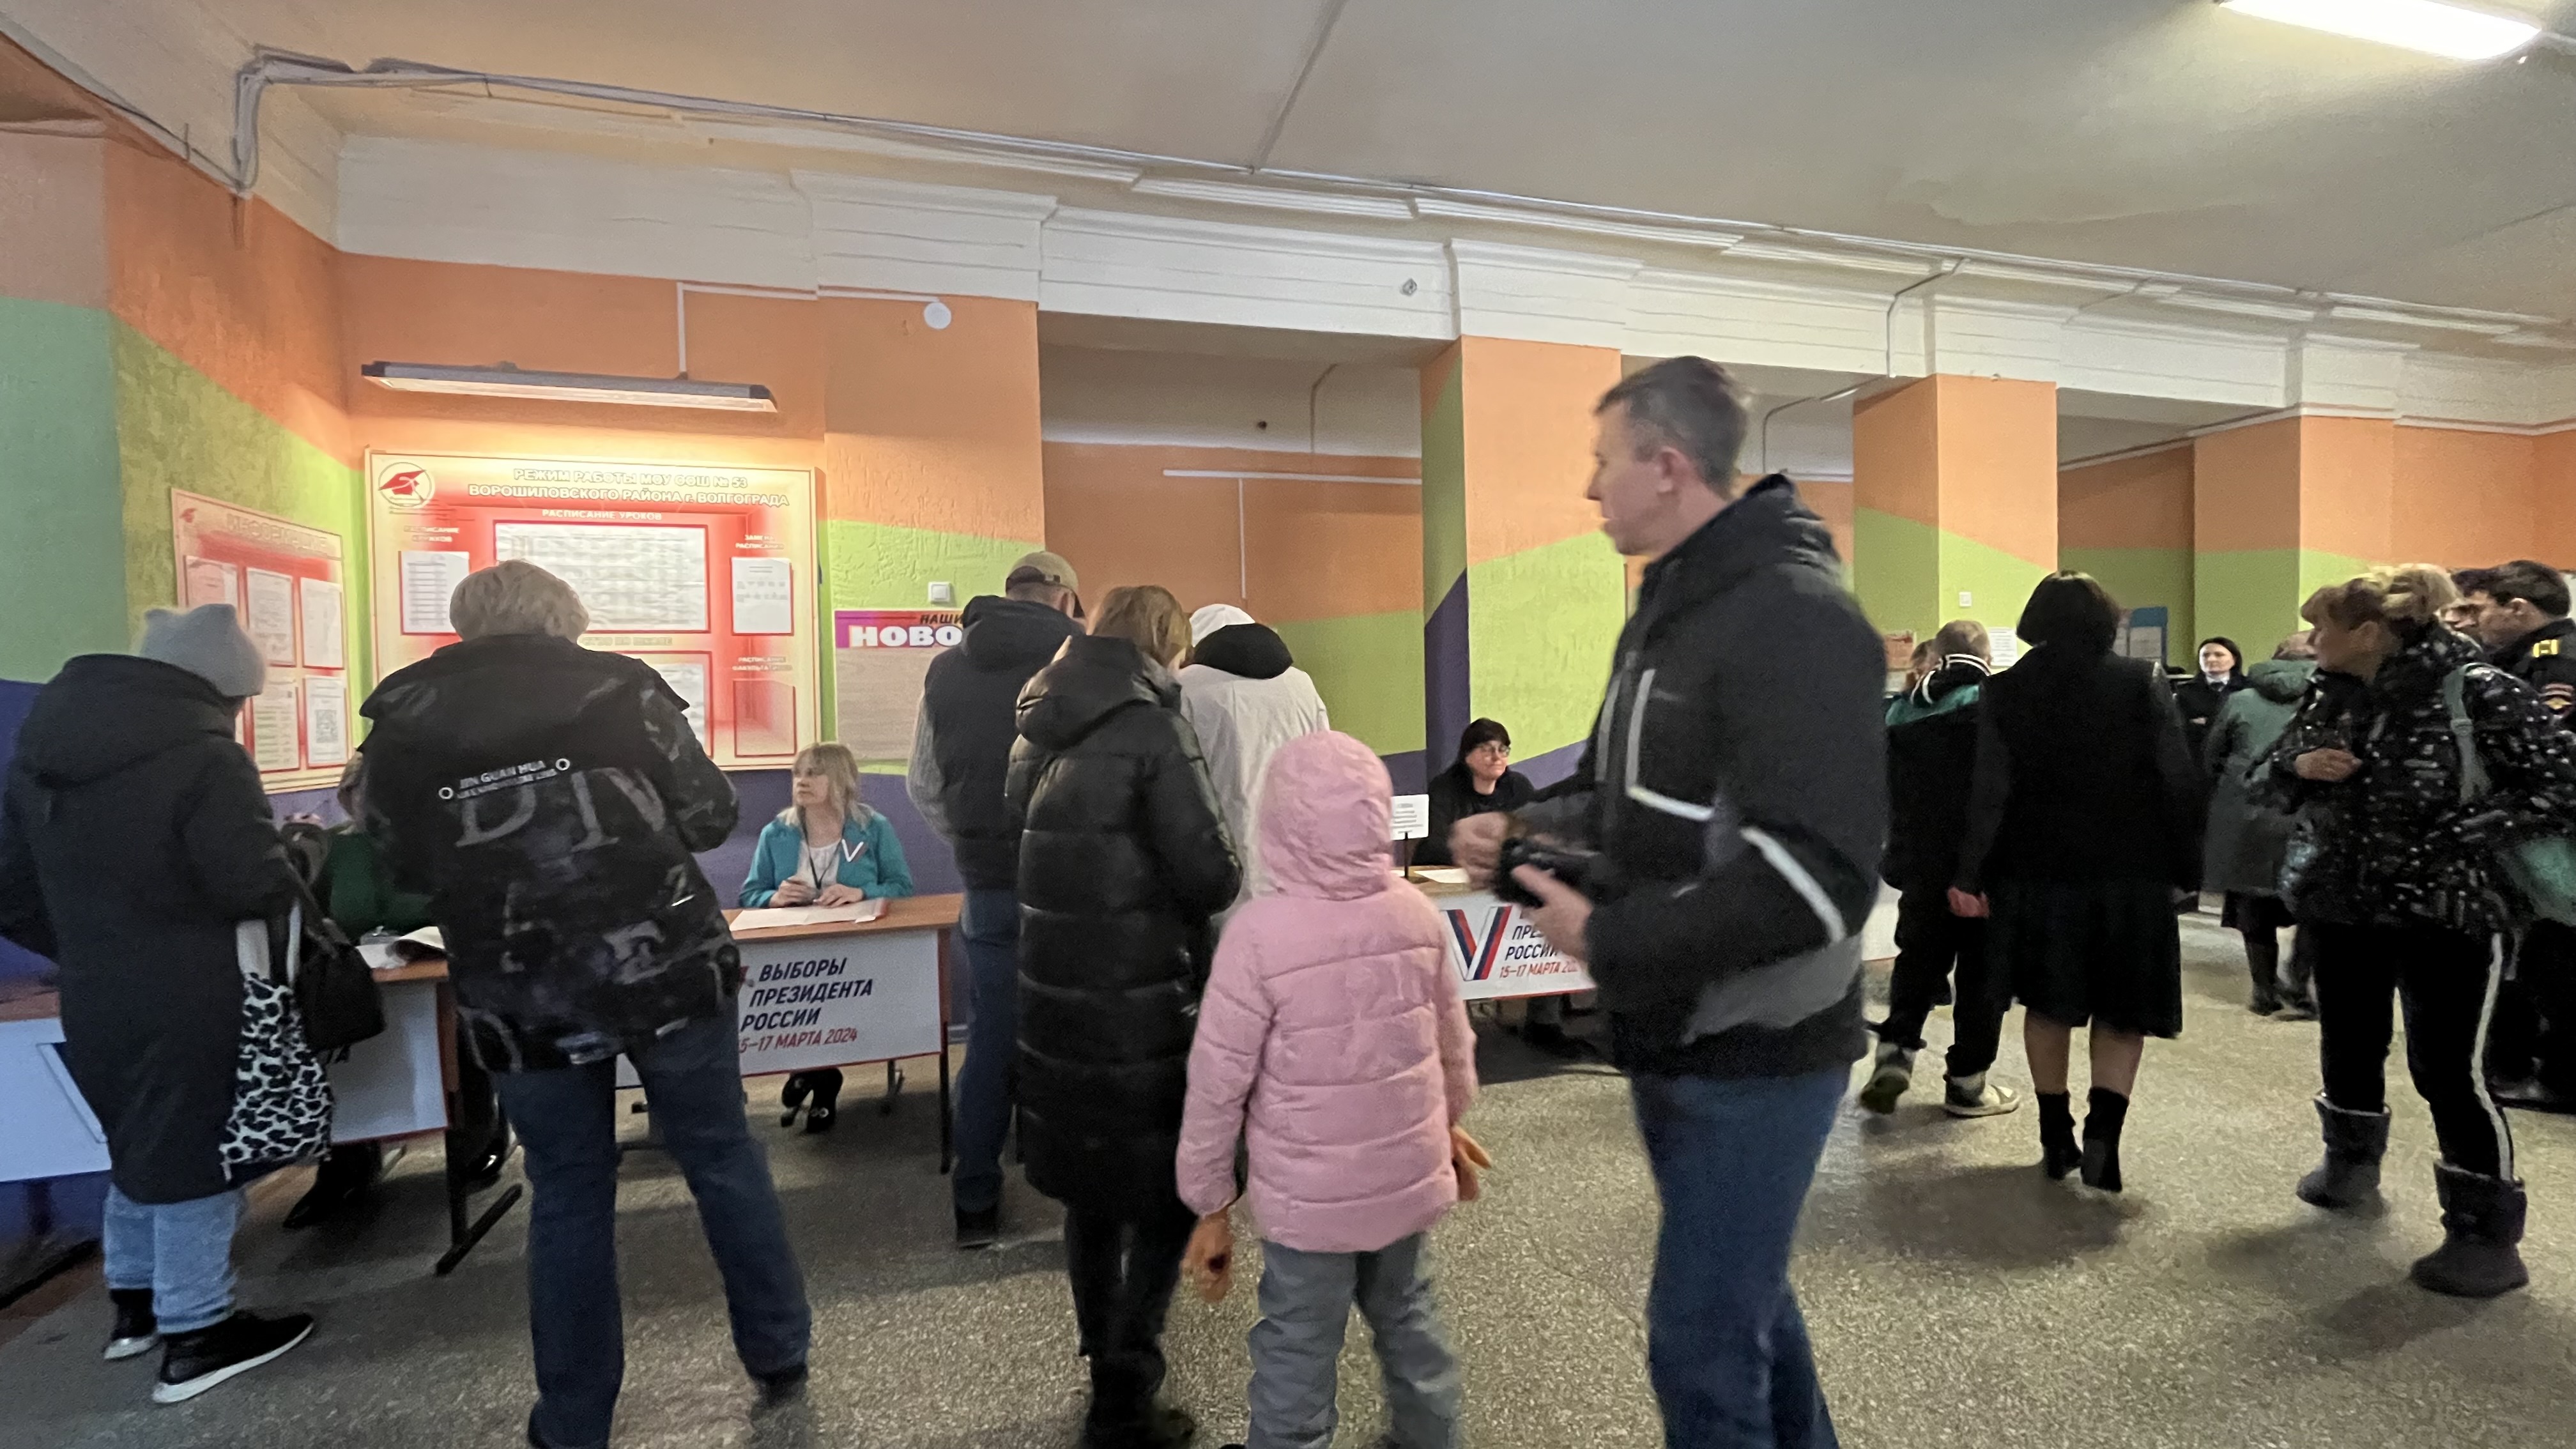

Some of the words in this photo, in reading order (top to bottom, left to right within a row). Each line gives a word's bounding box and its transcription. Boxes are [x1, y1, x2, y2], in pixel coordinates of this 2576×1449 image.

[514, 468, 571, 482] РЕЖИМ
[574, 470, 638, 484] РАБОТЫ
[713, 475, 730, 488] №
[732, 476, 748, 488] 53
[468, 484, 620, 500] ВОРОШИЛОВСКОГО
[622, 487, 682, 503] РАЙОНА
[684, 493, 695, 503] г.
[696, 492, 790, 507] ВОЛГОГРАДА
[542, 509, 616, 519] РАСПИСАНИЕ
[619, 510, 662, 521] УРОКОВ
[920, 614, 963, 624] НАШИ
[849, 625, 963, 647] НОВО
[758, 957, 848, 982] ВЫБОРЫ
[1528, 962, 1561, 976] МАРТА
[749, 978, 873, 1008] ПРЕЗИДЕНТА
[740, 1007, 822, 1032] РОССИИ
[739, 1034, 774, 1054] 5–17
[774, 1029, 822, 1049] МАРТА
[824, 1027, 858, 1045] 2024
